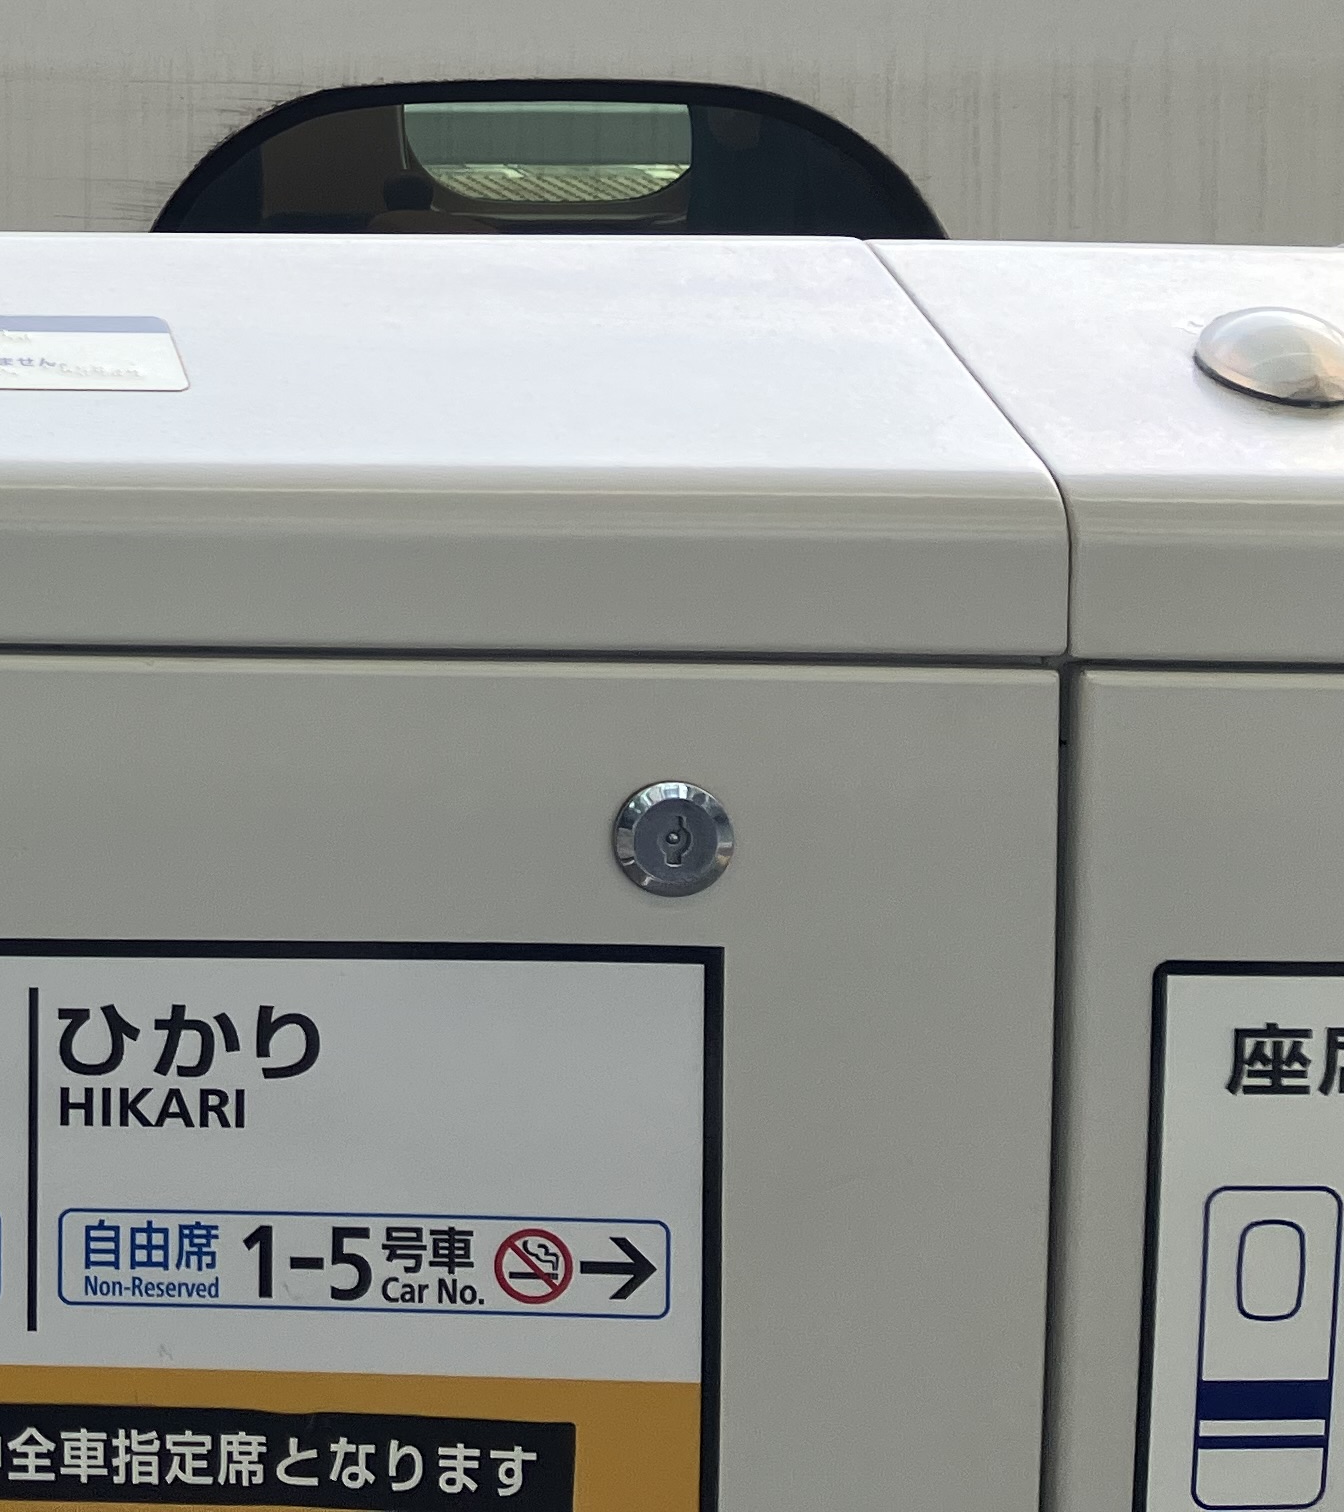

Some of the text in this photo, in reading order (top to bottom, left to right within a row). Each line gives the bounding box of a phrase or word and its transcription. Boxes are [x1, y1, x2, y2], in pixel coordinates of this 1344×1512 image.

[58, 1004, 320, 1079] ひかり
[60, 1087, 244, 1128] HIKARI
[86, 1221, 218, 1271] 自由席
[86, 1277, 218, 1297] Non-Reserved
[382, 1277, 485, 1305] Car No.
